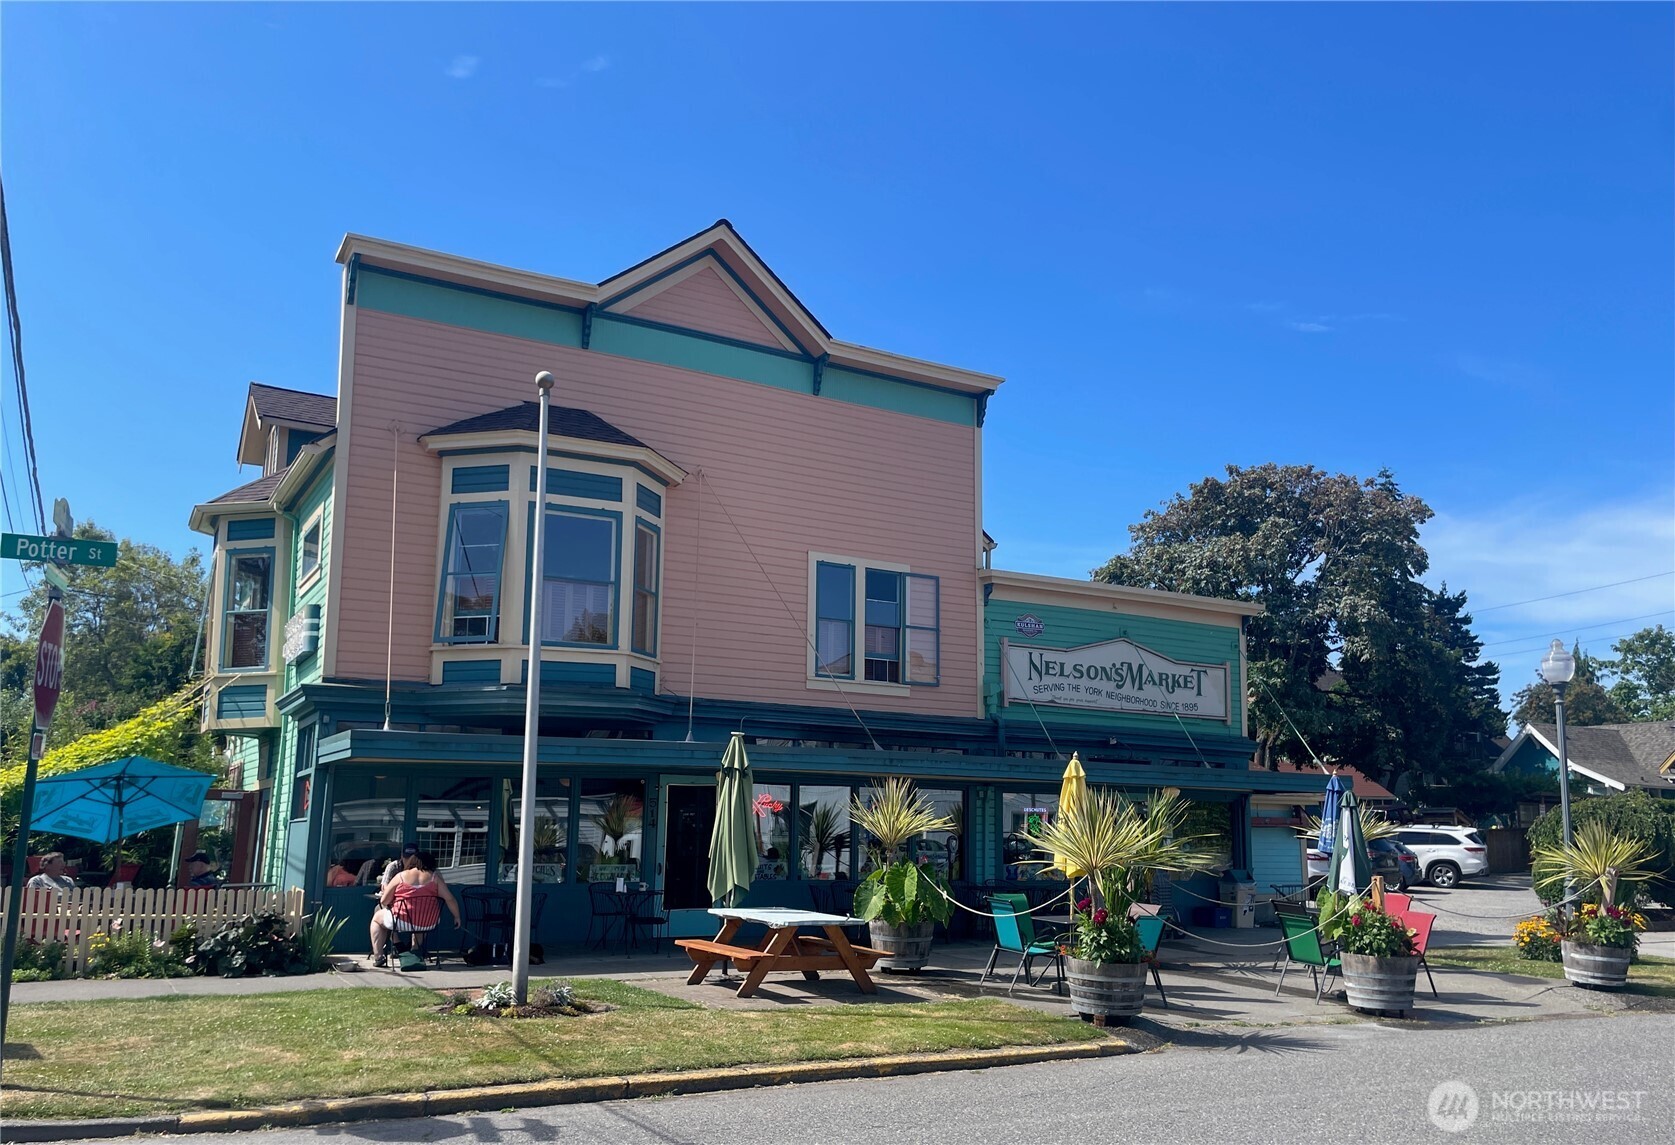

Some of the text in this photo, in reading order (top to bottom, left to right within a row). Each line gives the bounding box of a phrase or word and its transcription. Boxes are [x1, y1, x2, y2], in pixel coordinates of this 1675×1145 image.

[16, 538, 102, 560] Potter St
[37, 640, 62, 690] STOP
[1033, 683, 1065, 695] SERVING
[1067, 683, 1081, 693] THE
[1084, 685, 1103, 698] YORK
[1105, 690, 1158, 708] NEIGHBORHOOD
[1160, 700, 1180, 711] SINCE
[1181, 702, 1199, 712] 1895
[648, 797, 657, 828] 514
